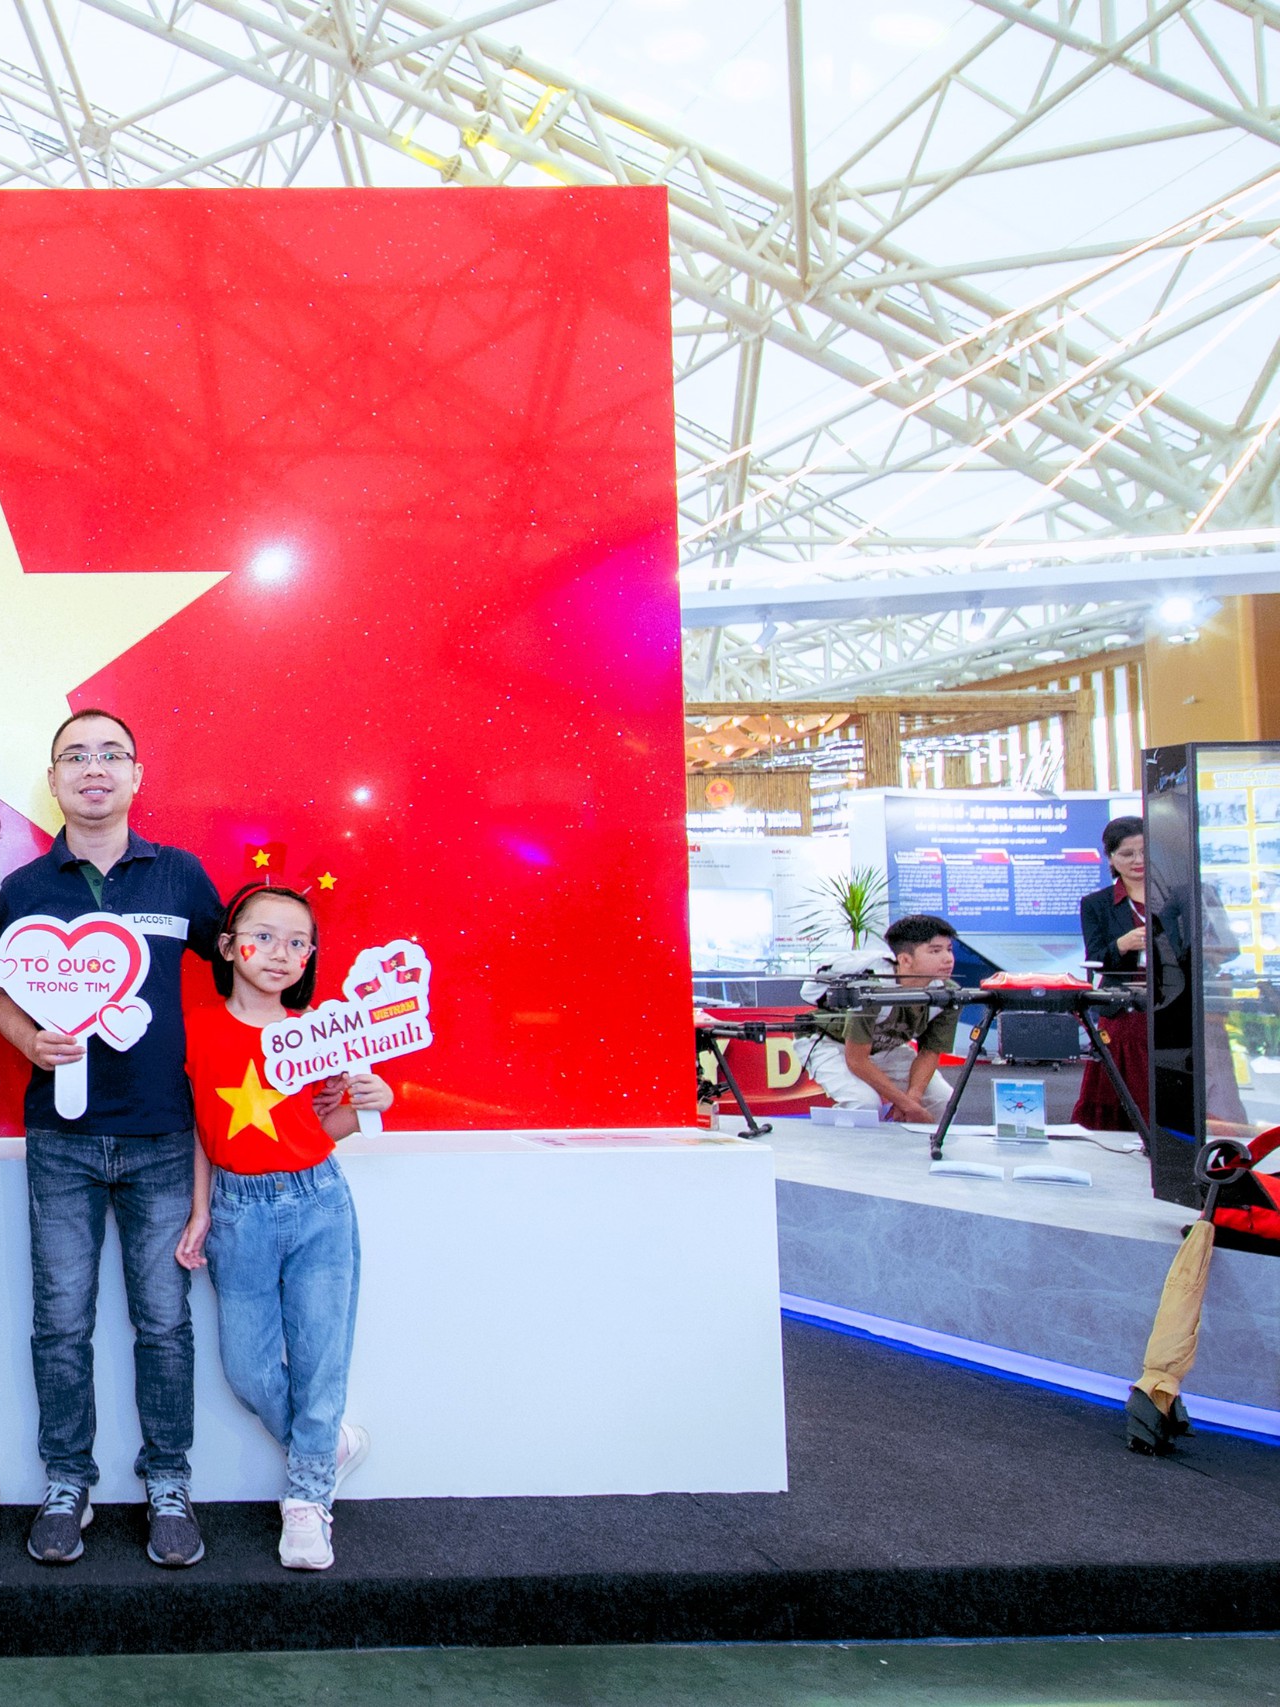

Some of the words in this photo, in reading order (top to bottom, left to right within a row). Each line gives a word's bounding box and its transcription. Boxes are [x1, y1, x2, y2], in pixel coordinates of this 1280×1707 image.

[133, 915, 173, 925] LACOSTE
[26, 981, 79, 994] TRONG
[84, 982, 110, 993] TIM
[372, 1000, 416, 1021] VIETNAM
[272, 1029, 303, 1053] 80
[310, 1011, 364, 1042] NĂM
